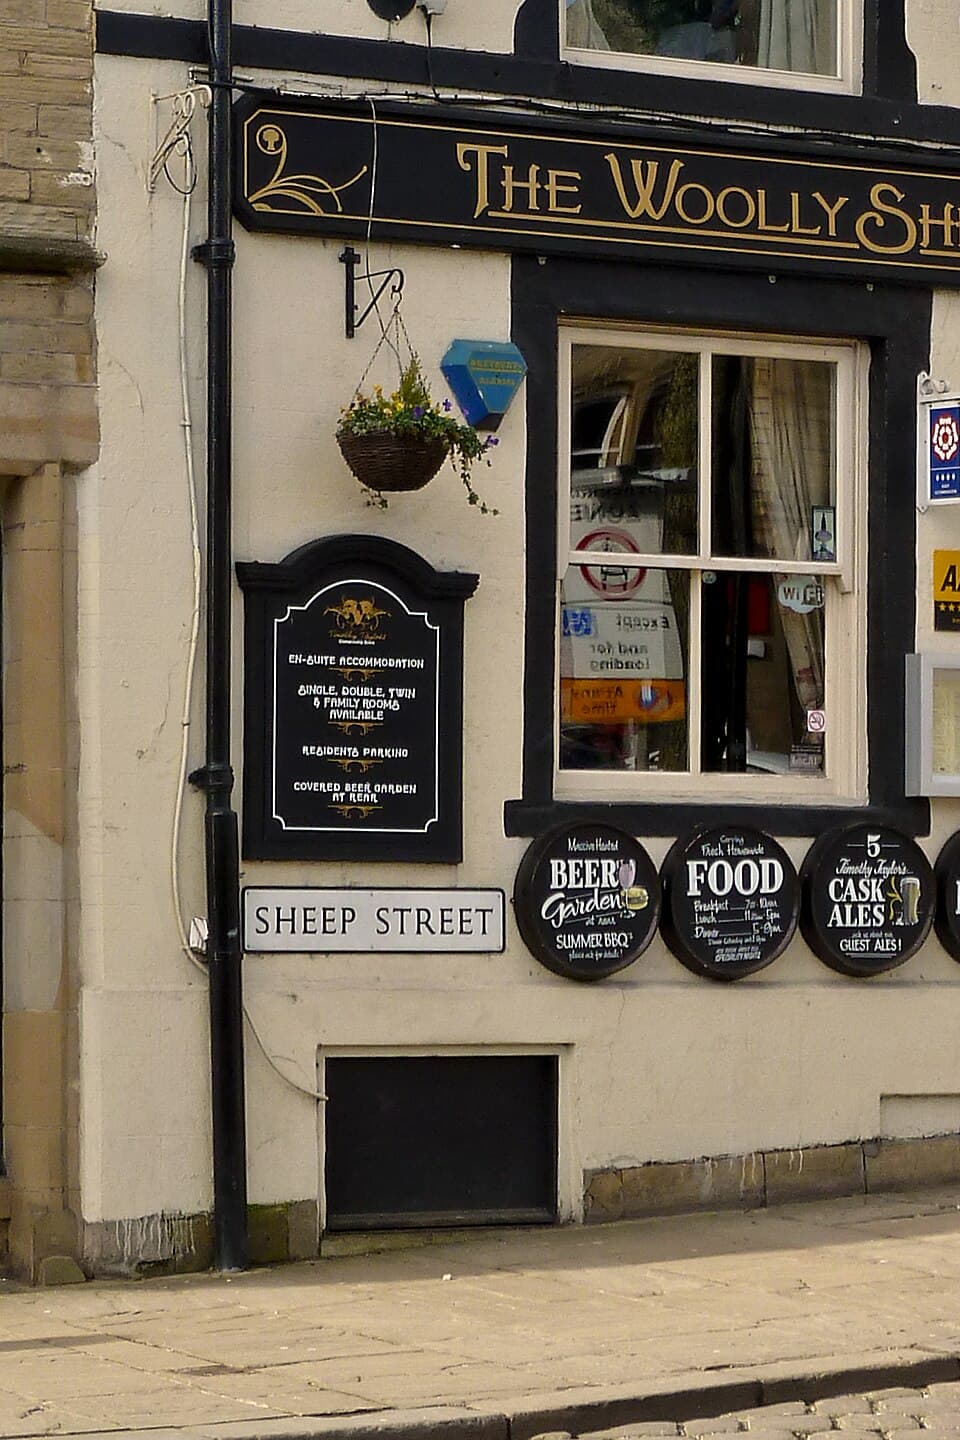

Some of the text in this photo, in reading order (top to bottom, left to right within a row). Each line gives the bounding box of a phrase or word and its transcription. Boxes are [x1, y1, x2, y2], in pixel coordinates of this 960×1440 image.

[455, 142, 583, 218] THE
[604, 152, 850, 236] WOOLLY
[288, 654, 424, 669] EN-SUITE ACCOMMODATION
[388, 687, 416, 699] TWIN
[323, 697, 360, 709] FAMILY
[362, 698, 400, 711] ROOMS
[329, 709, 384, 720] AVAILABLE
[302, 745, 408, 758] RESIDENTS PARKING
[293, 782, 417, 795] COVERED BEER GARDEN
[332, 792, 378, 803] AT REAR
[867, 834, 881, 858] 5
[549, 859, 620, 890] BEER
[686, 859, 784, 897] FOOD
[828, 878, 886, 904] CASK
[541, 888, 623, 929] Garden
[826, 903, 886, 928] ALES
[255, 906, 494, 936] SHEEP STREET
[556, 932, 603, 950] SUMMER
[839, 938, 871, 952] GUEST
